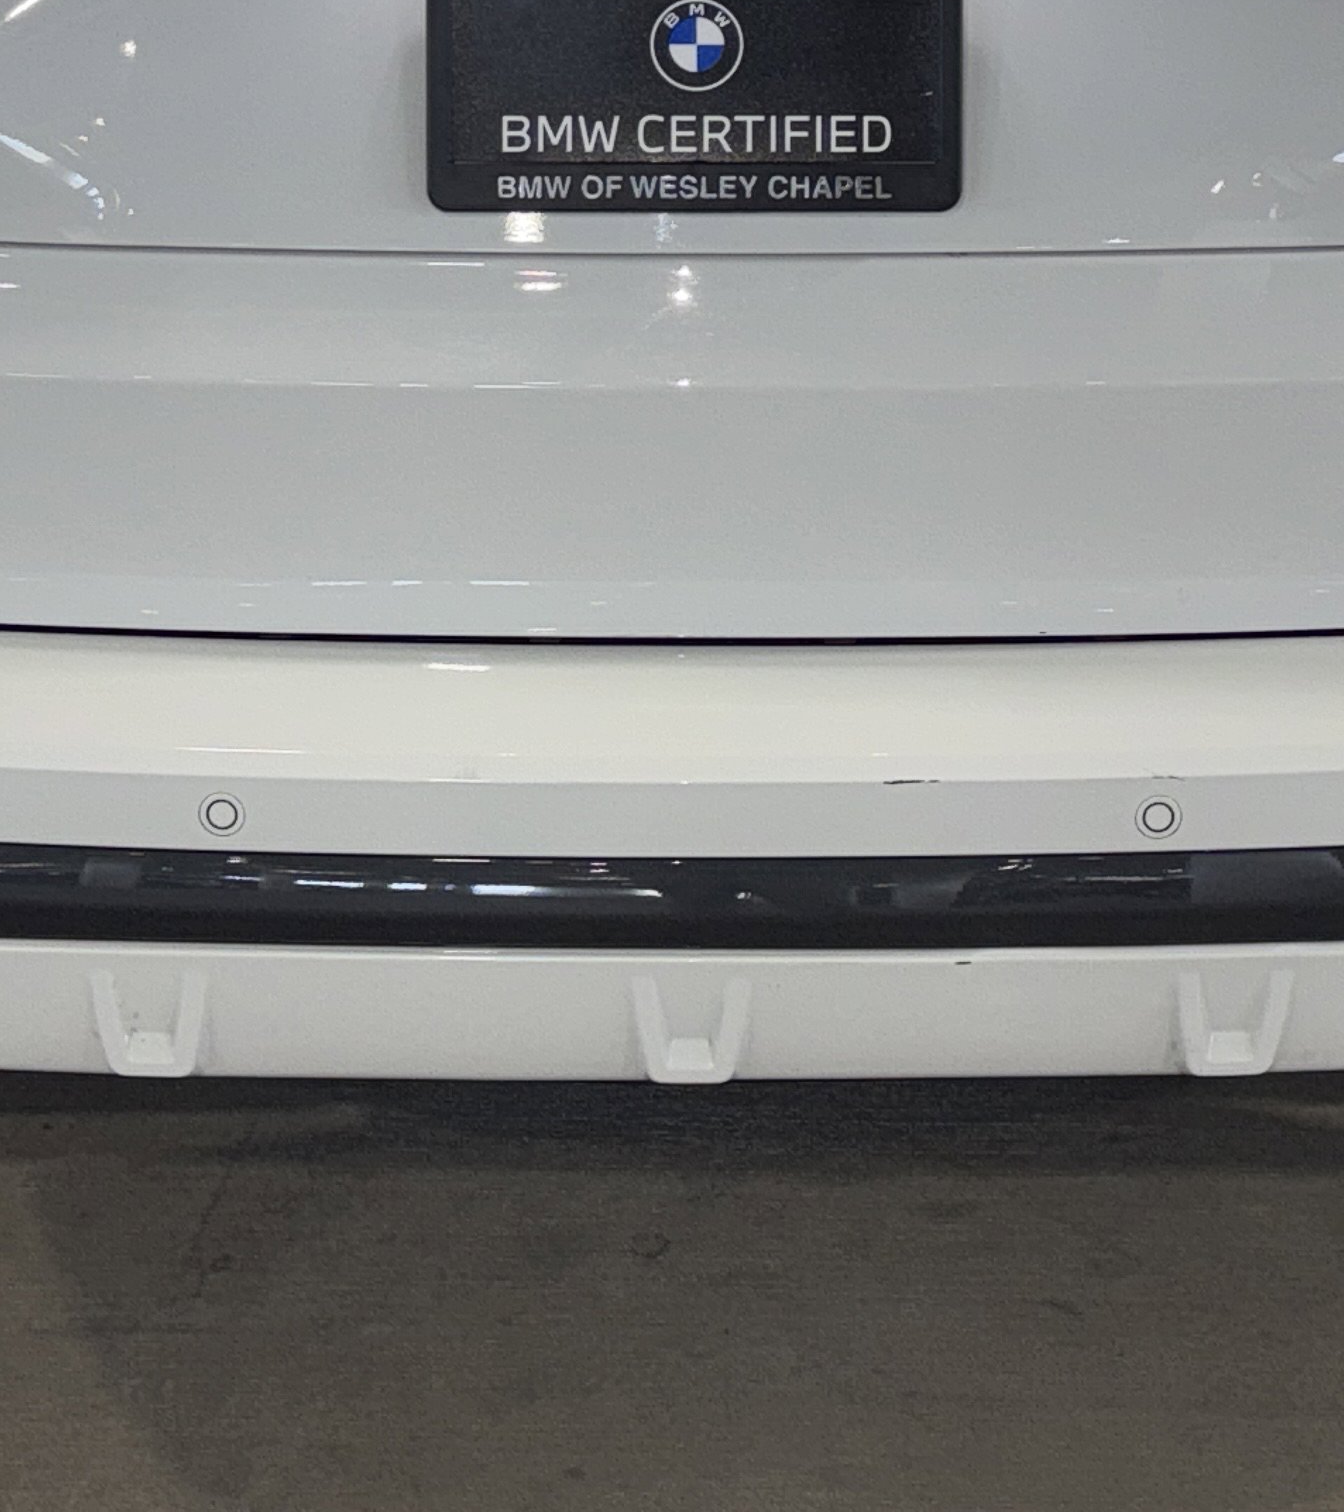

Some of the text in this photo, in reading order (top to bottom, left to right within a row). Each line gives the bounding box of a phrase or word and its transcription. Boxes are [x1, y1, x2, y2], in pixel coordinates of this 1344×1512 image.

[663, 3, 731, 29] BMW
[500, 113, 893, 154] BMW CERTIFIED
[497, 174, 893, 200] BMW OF WESLEY CHAPEL
